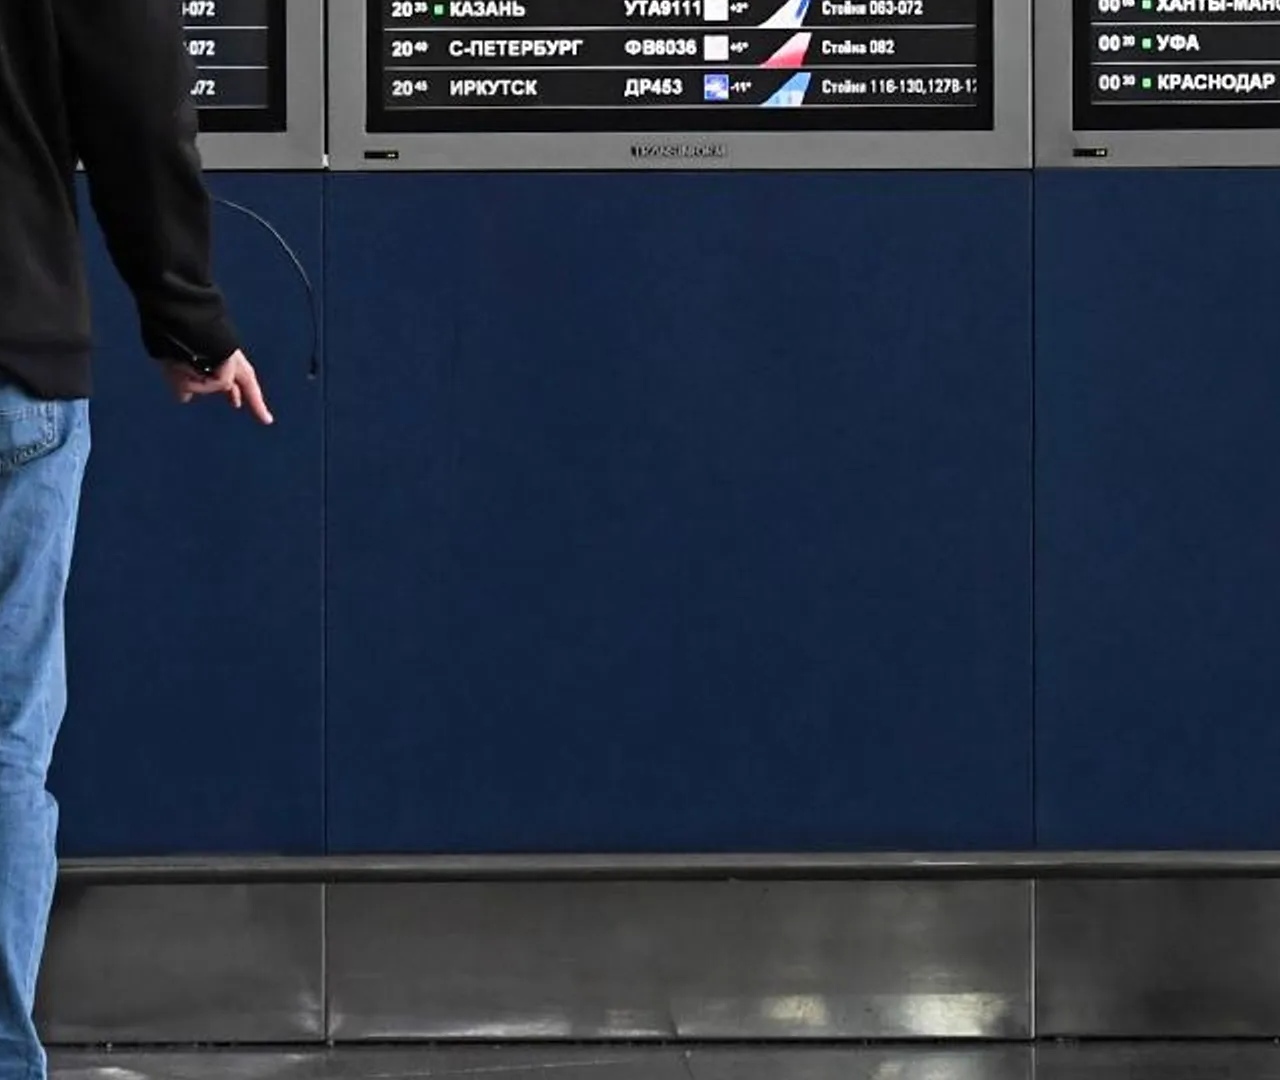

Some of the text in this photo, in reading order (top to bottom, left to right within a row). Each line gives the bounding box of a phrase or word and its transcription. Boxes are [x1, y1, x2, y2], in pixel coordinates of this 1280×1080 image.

[450, 1, 525, 16] КАЗАНЬ
[450, 40, 583, 56] С-ПЕТЕРБУРГ
[1157, 35, 1199, 51] УФА
[451, 80, 537, 95] ИРКУТСК
[1158, 74, 1275, 92] КРАСНОДАР
